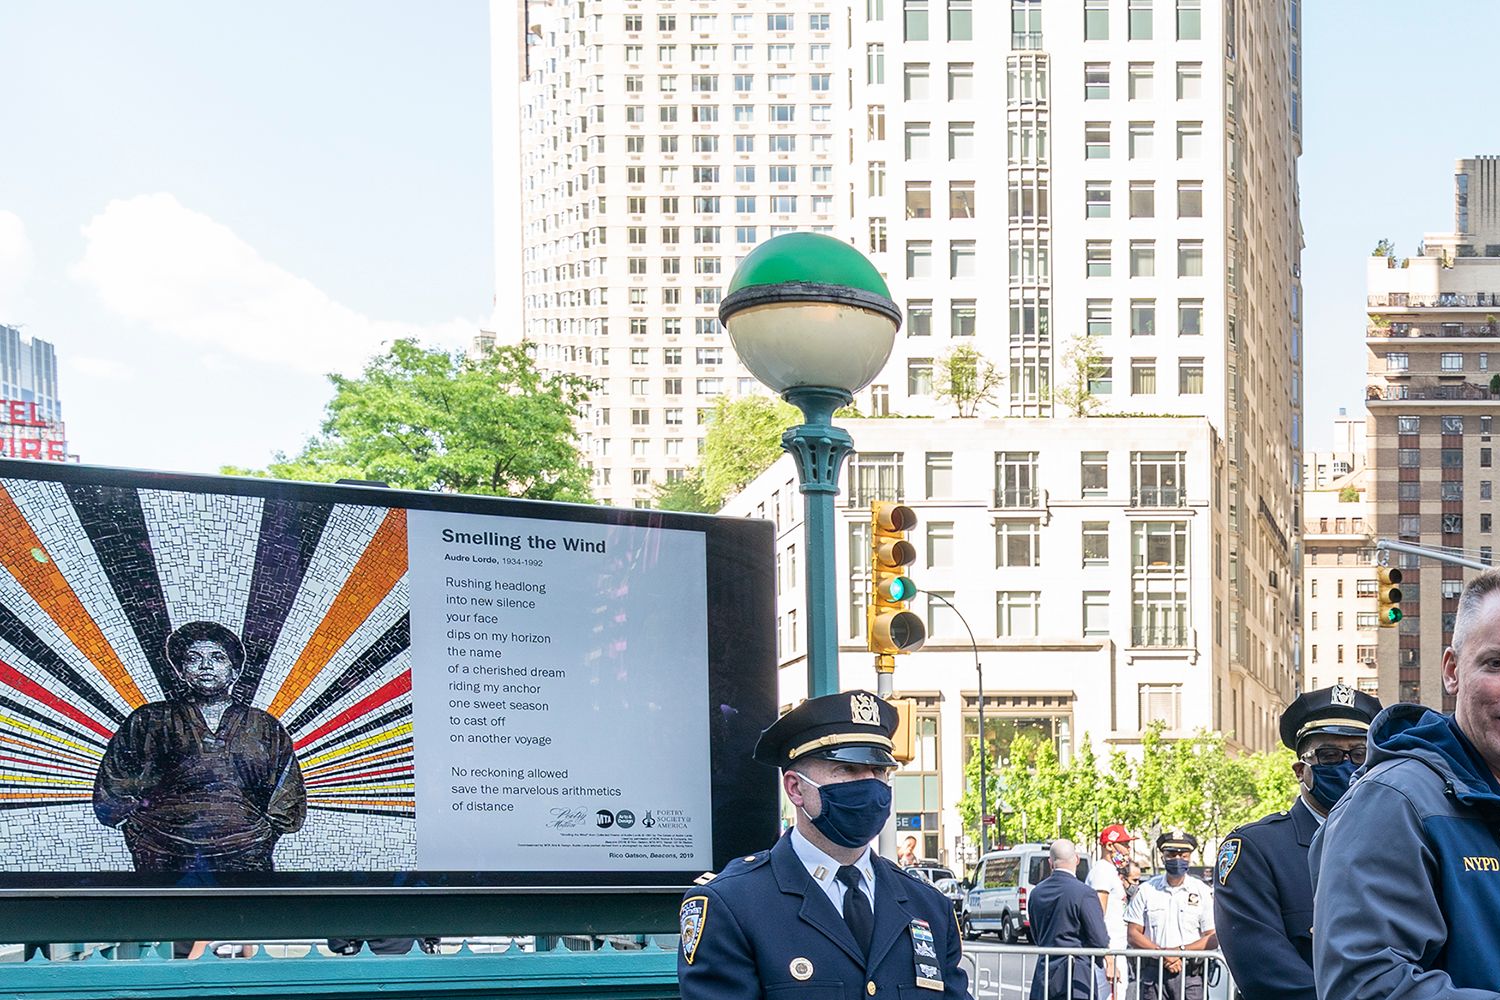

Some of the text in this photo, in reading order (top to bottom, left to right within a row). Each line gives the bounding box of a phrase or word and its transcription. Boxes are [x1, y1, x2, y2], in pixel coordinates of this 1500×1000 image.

[441, 528, 606, 554] Smelling the Wind
[444, 553, 544, 567] Audre Lorde, 1934-1992
[446, 576, 547, 595] Rushing headlong
[446, 594, 536, 609] into new silence
[446, 612, 499, 624] your face
[447, 629, 551, 644] dips on my horizon
[447, 646, 502, 659] the name
[447, 663, 566, 678] of a cherished dream
[449, 681, 541, 695] riding my anchor
[449, 699, 549, 711] one sweet season
[449, 715, 506, 727] to cast off
[449, 733, 552, 747] on another voyage
[451, 766, 569, 781] No reckoning allowed
[451, 784, 622, 797] save the marvelous arithmetics
[452, 801, 515, 812] of distance
[624, 852, 649, 860] Gatson,
[649, 852, 678, 860] Beacons,
[1463, 856, 1500, 872] NYPD
